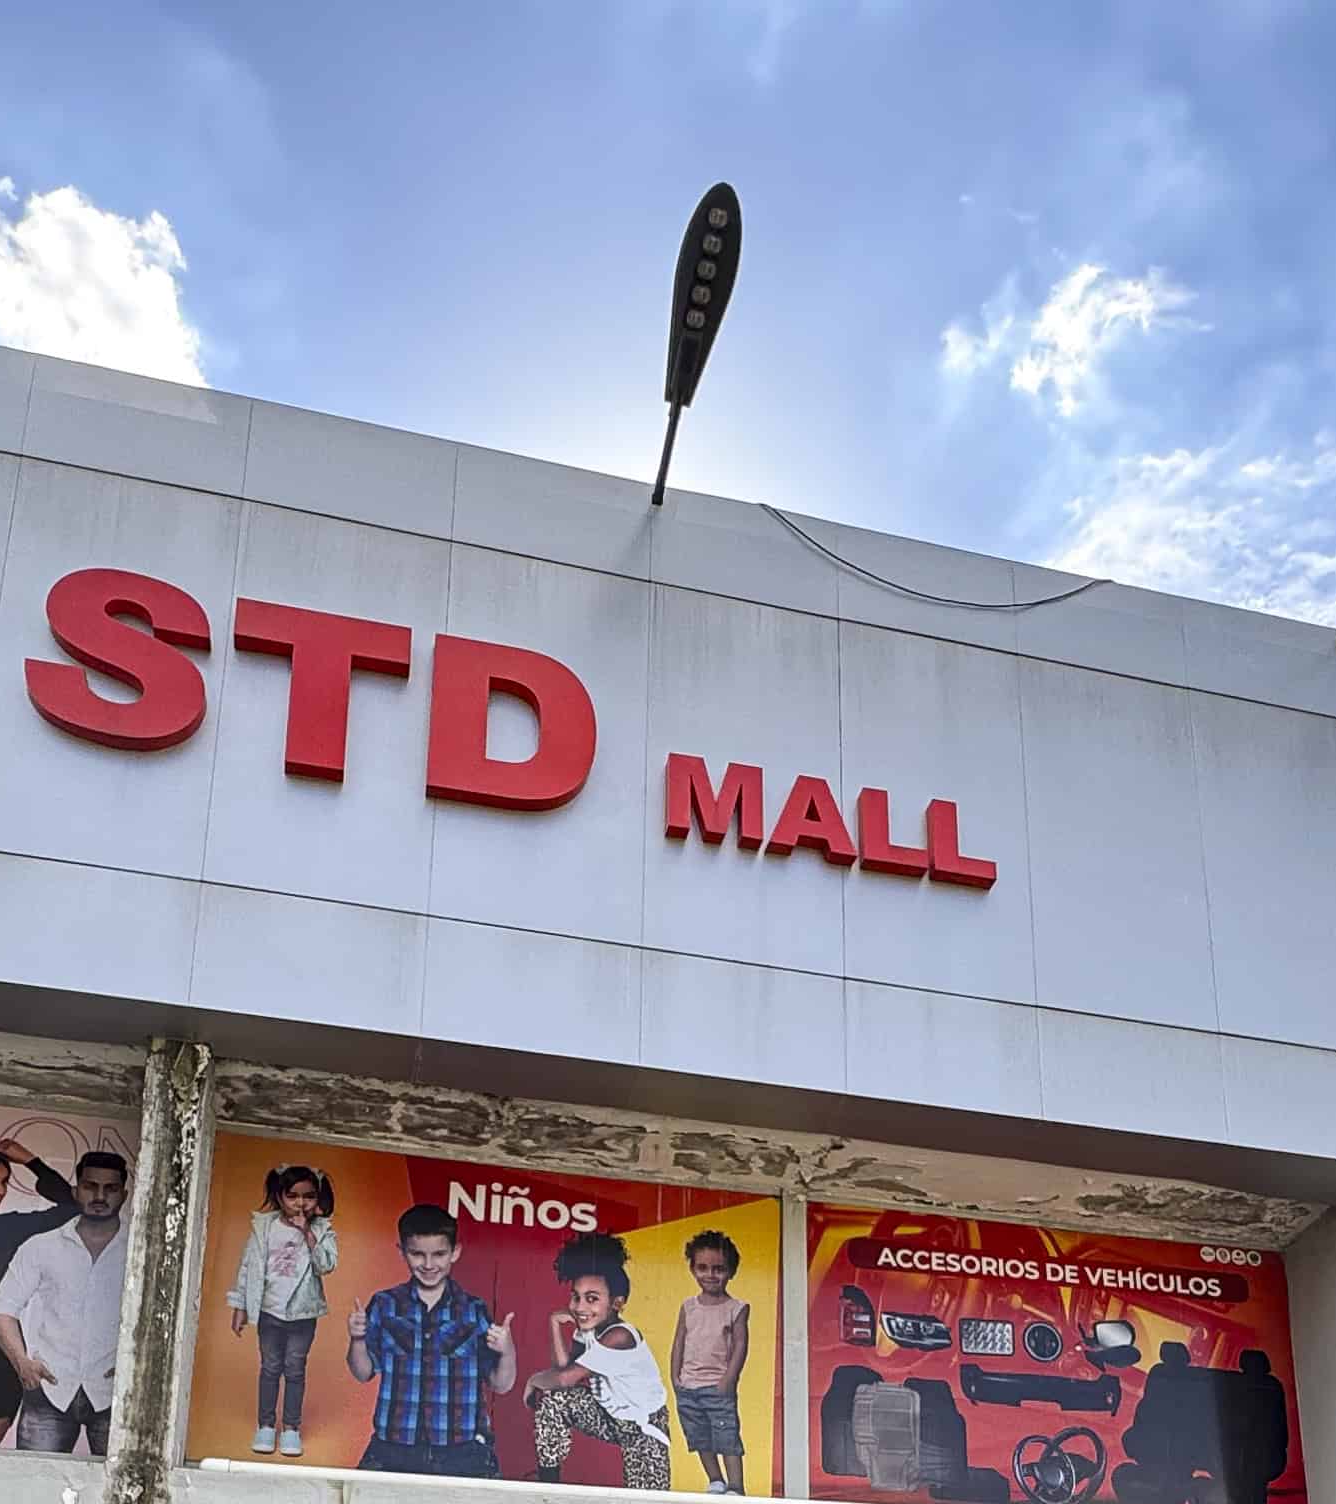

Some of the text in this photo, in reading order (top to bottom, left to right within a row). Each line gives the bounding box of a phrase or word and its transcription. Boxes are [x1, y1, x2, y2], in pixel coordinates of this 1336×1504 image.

[24, 567, 998, 889] STD MALL
[447, 1180, 598, 1233] Niños
[876, 1247, 1223, 1298] ACCESORIOS DE VEHÍCULOS
